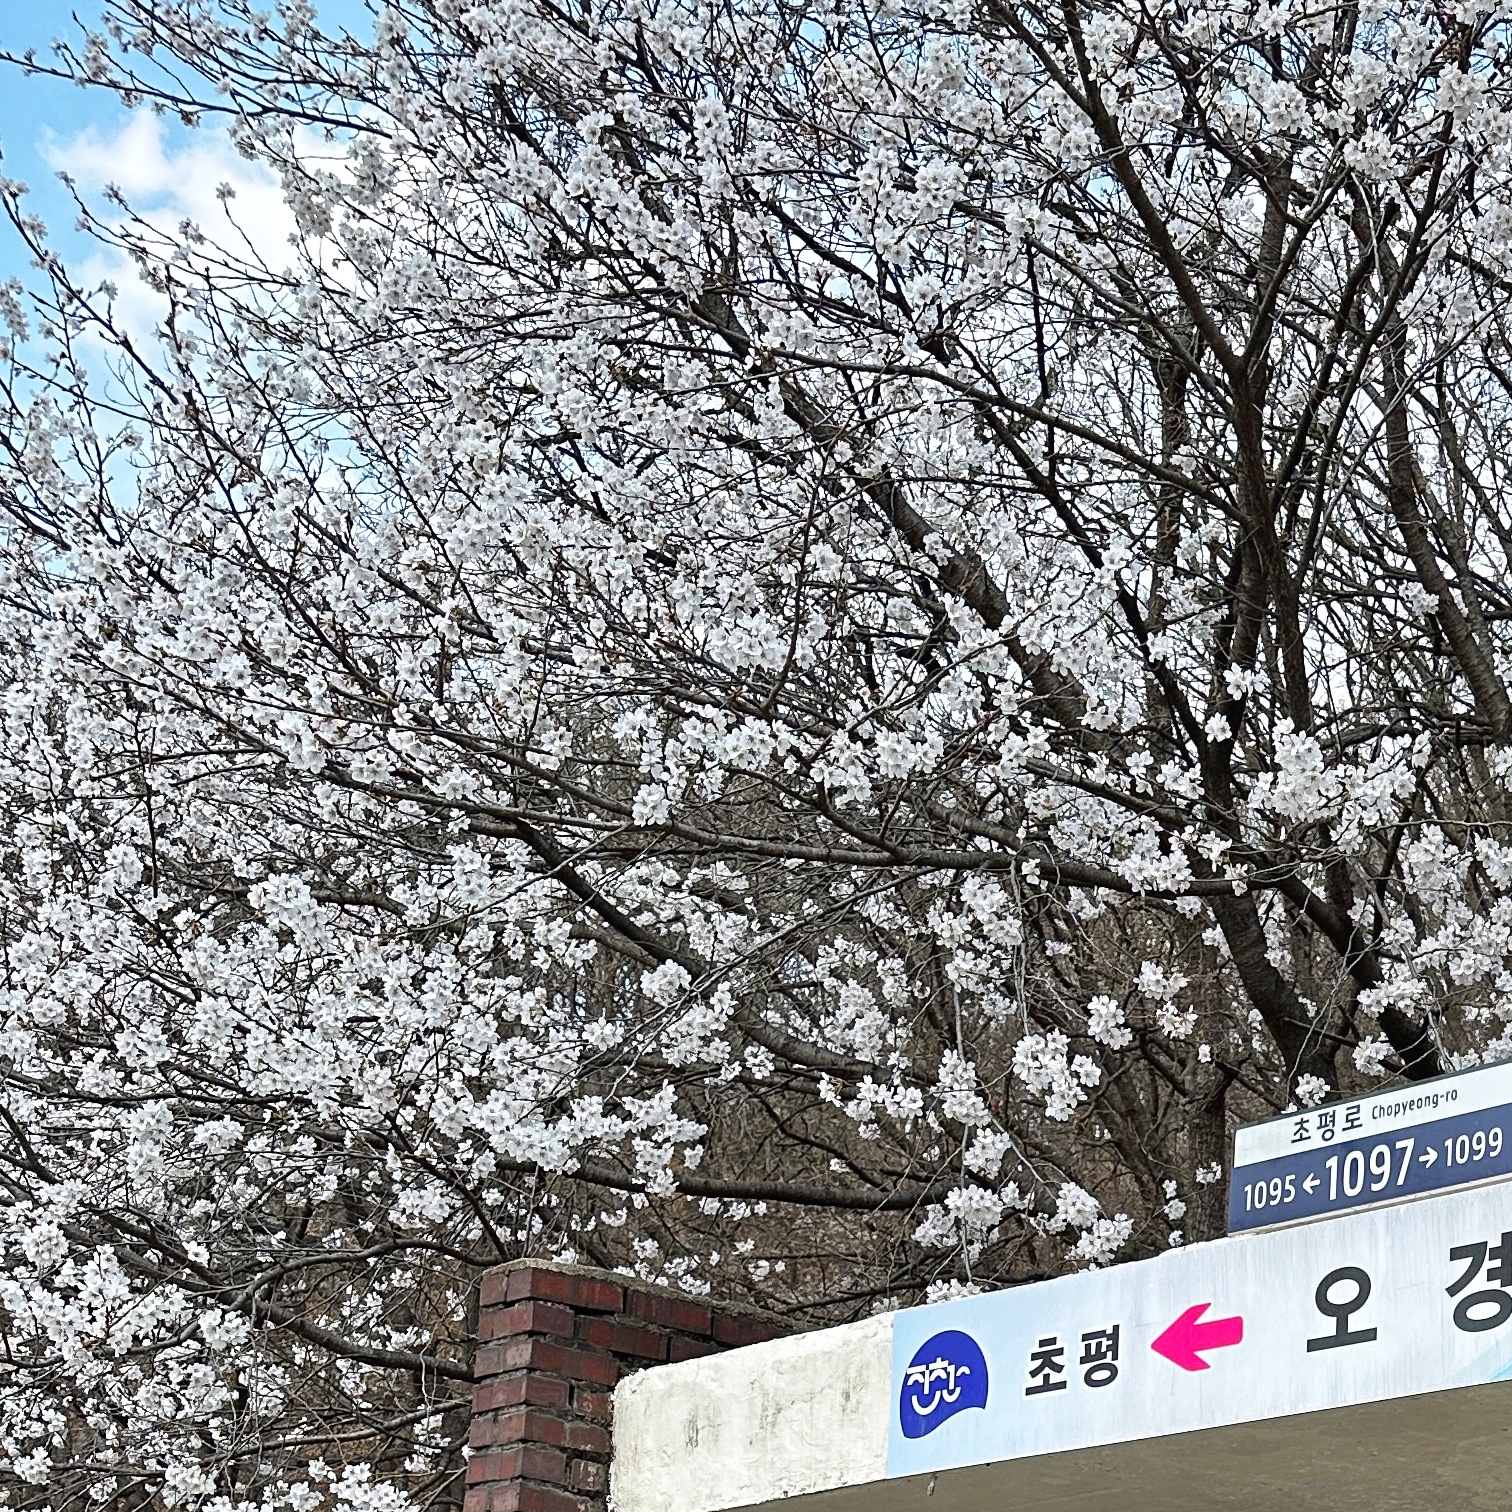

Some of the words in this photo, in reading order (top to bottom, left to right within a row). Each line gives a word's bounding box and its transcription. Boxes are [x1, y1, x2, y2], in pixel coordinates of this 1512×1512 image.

[1291, 1104, 1363, 1143] 초평로
[1371, 1088, 1458, 1120] Chopyeong-ro
[1244, 1174, 1296, 1211] 1095
[1326, 1137, 1415, 1201] 1097
[1444, 1126, 1503, 1167] 1099
[1025, 1323, 1120, 1397] 초평
